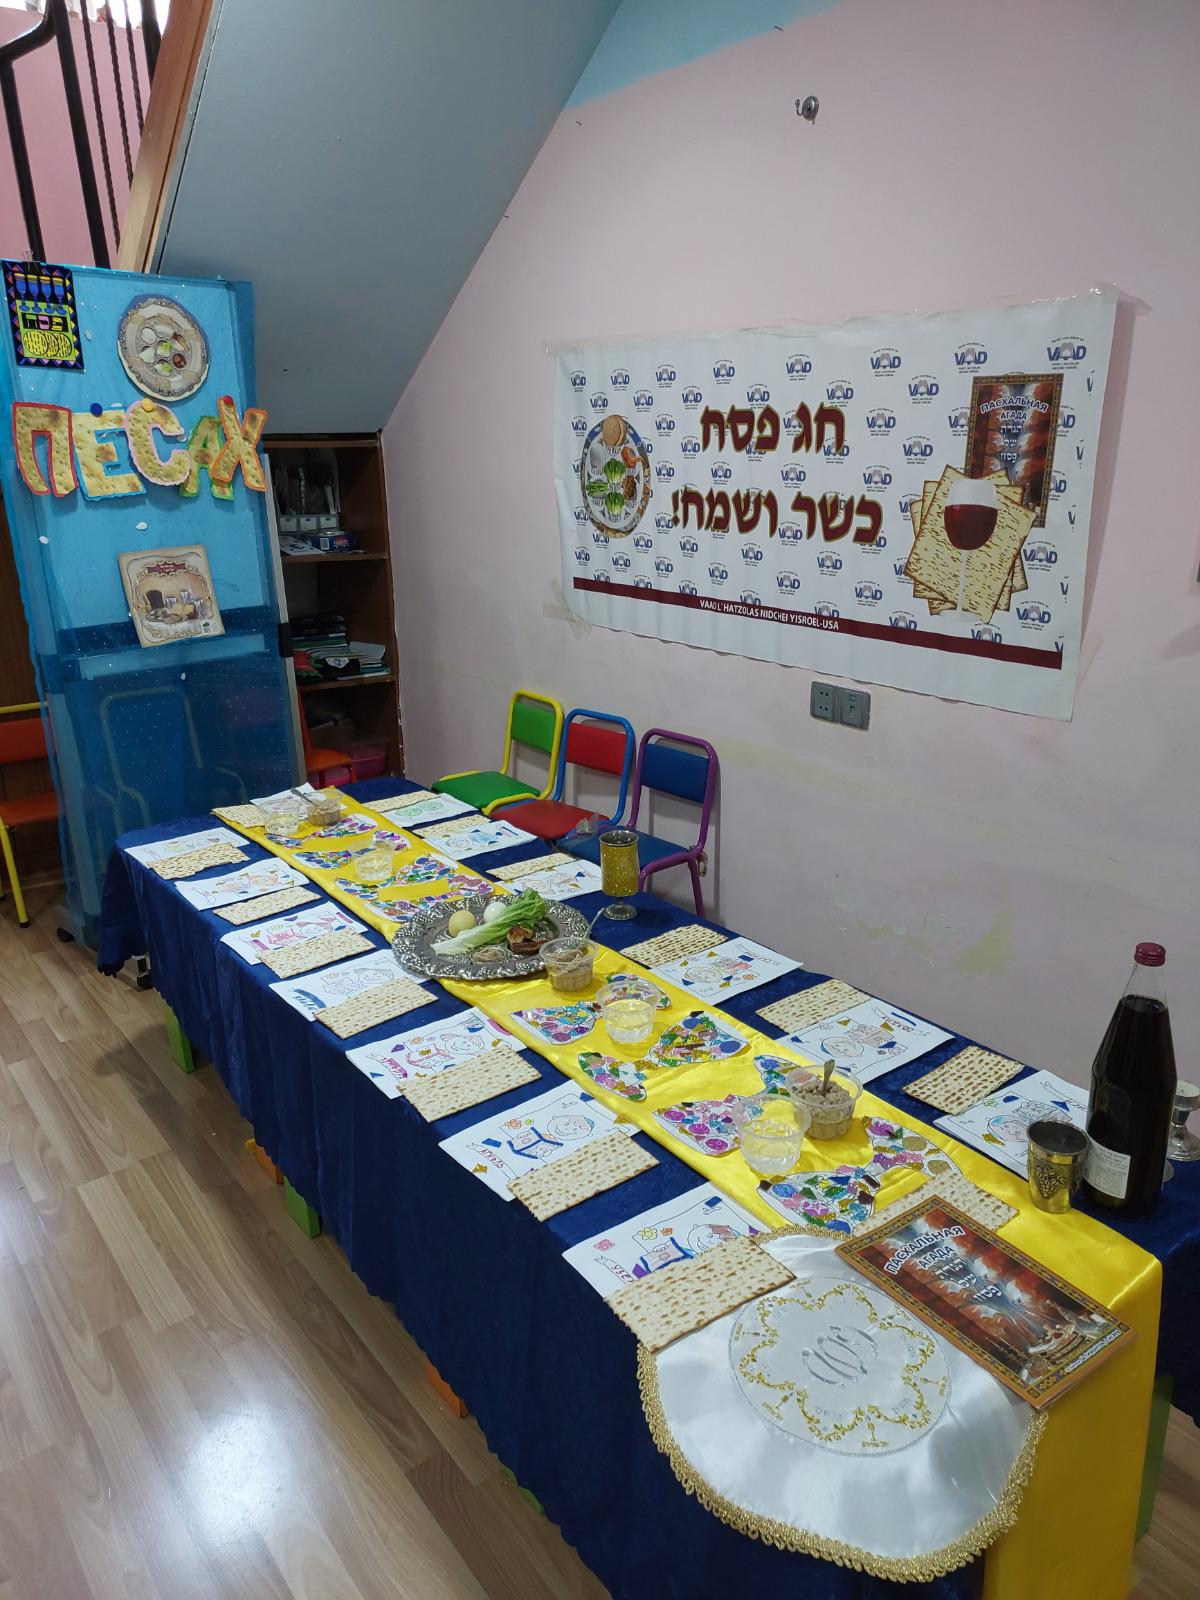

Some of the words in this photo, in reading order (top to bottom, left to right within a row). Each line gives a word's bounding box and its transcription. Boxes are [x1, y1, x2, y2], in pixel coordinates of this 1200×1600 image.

[701, 404, 780, 453] פסח
[792, 401, 845, 453] חג
[980, 396, 1049, 414] ПАСХАЛЬНАЯ
[1000, 411, 1027, 421] АГАДА
[12, 396, 268, 501] ПЕСАХ
[672, 486, 778, 538] ושמח!
[791, 491, 883, 544] כשר
[700, 600, 717, 609] VAAD
[760, 610, 788, 622] NIDCHEI
[790, 615, 839, 630] YISROEL-USA
[884, 1226, 965, 1274] ПАСХАЛЬНАЯ
[917, 1245, 955, 1270] АГАДА
